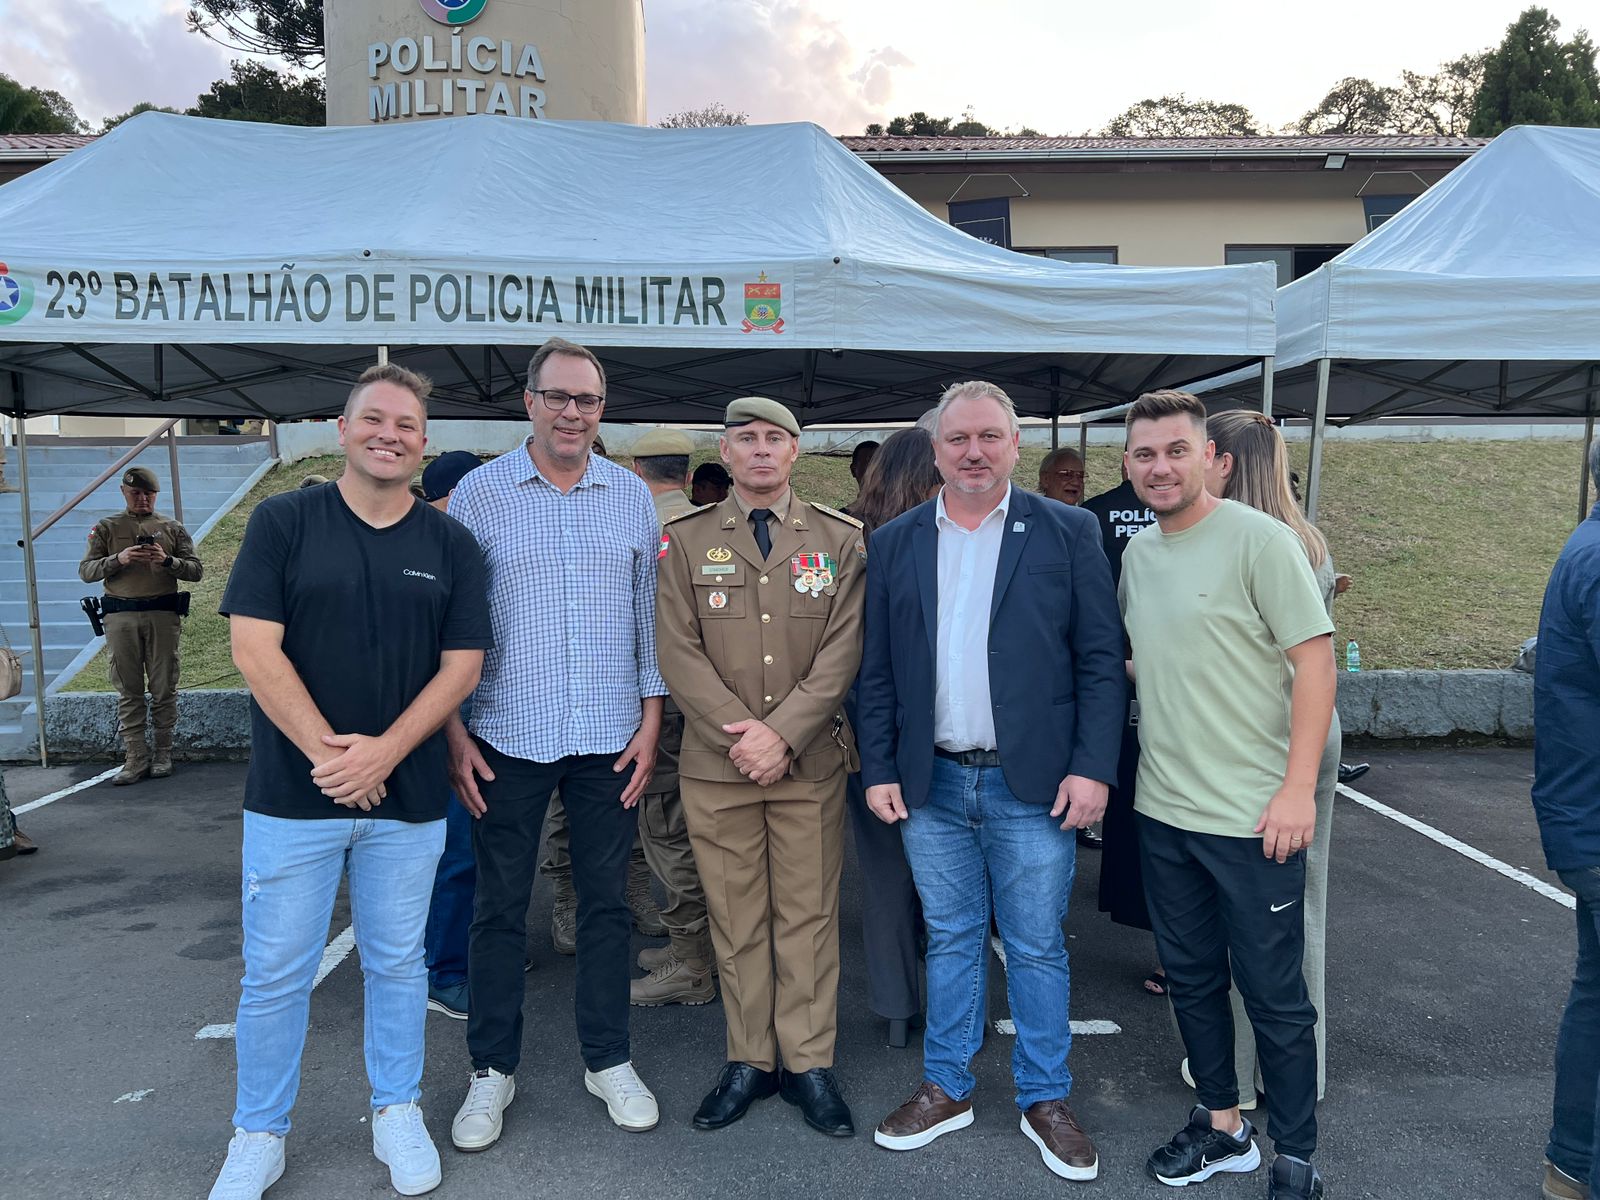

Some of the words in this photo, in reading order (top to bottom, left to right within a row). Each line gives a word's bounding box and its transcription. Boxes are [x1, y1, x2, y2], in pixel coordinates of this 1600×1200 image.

[368, 27, 546, 83] POLÍCIA
[369, 78, 547, 121] MILITAR
[45, 270, 103, 319] 23º
[114, 263, 332, 323] BATALHÃO
[345, 273, 395, 322] DE
[409, 274, 563, 323] POLICIA
[575, 275, 728, 326] MILITAR
